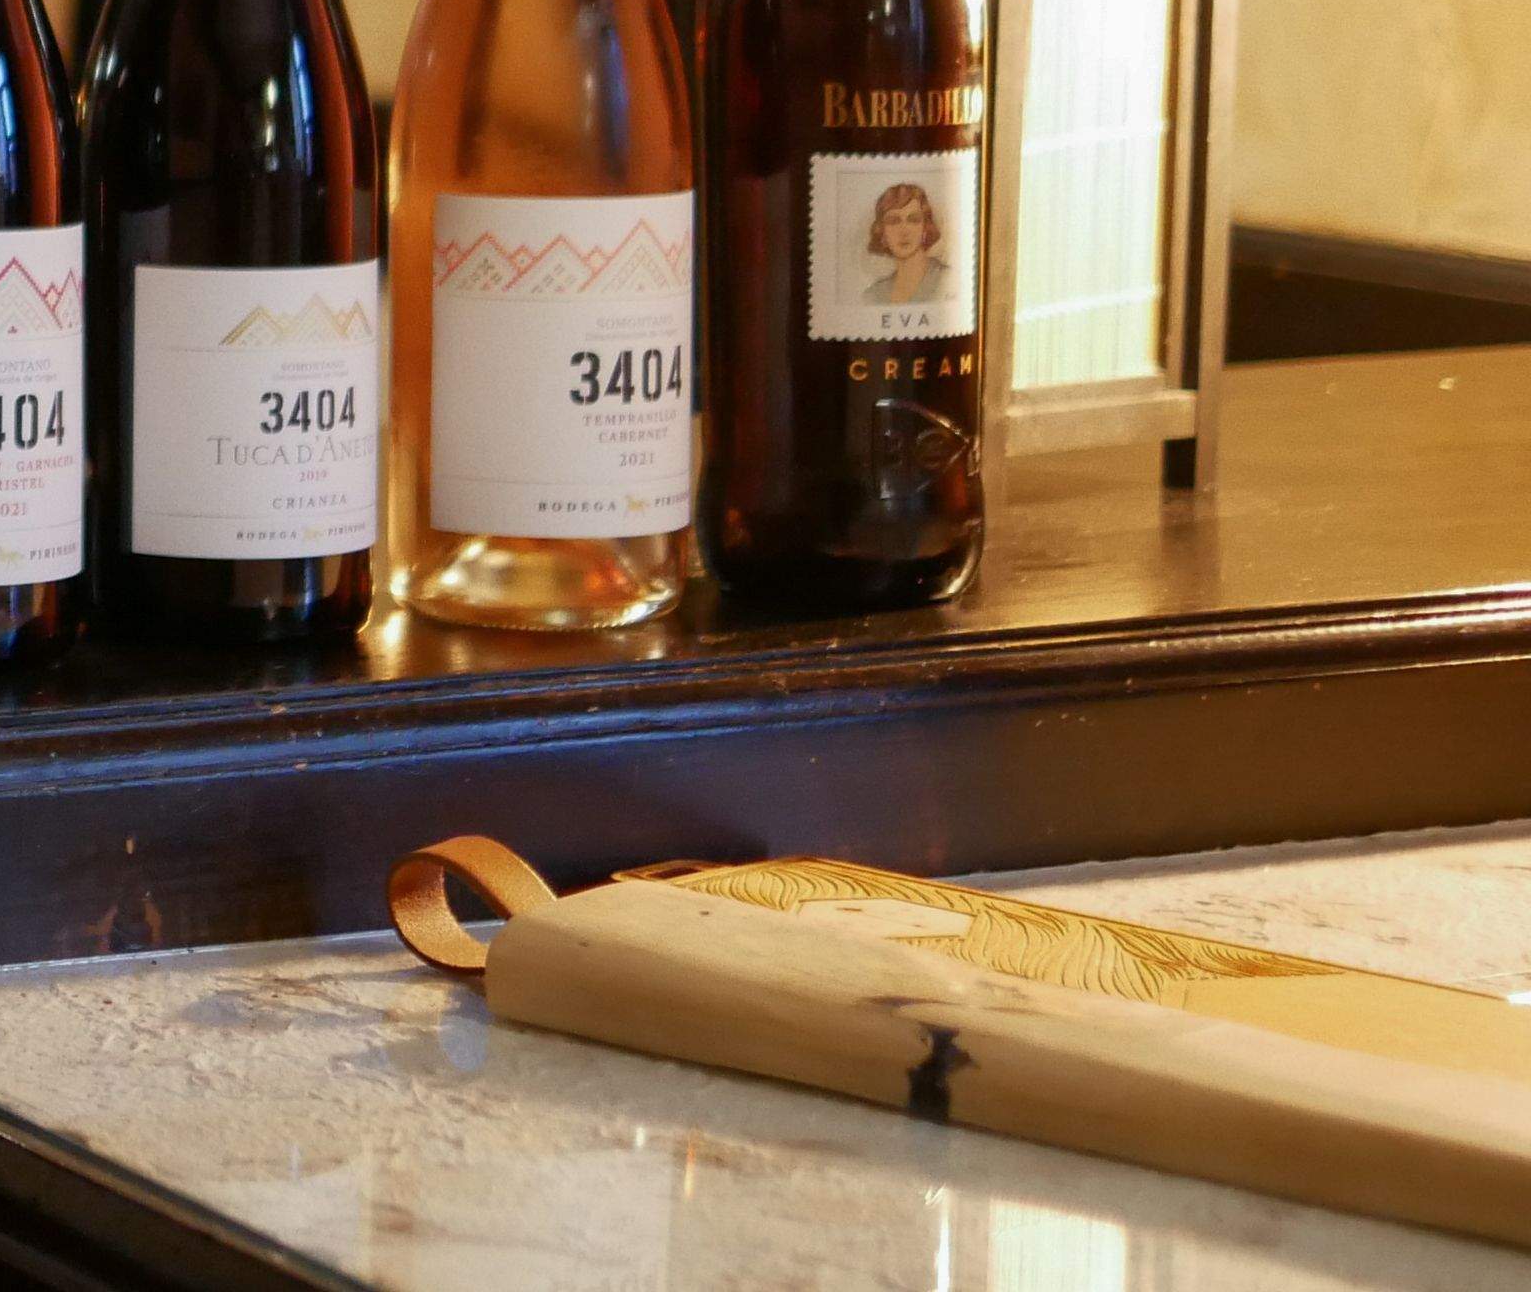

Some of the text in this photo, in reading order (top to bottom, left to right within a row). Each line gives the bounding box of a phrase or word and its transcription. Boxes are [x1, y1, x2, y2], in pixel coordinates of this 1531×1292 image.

[881, 312, 931, 329] EVA
[568, 344, 683, 406] 3404
[848, 354, 973, 382] CREAM
[259, 386, 356, 435] 3404
[598, 427, 669, 445] CABERNET
[619, 451, 656, 468] 2021
[272, 494, 349, 510] CRIANZA
[538, 500, 618, 514] BODEGA
[236, 530, 299, 542] BODEGA
